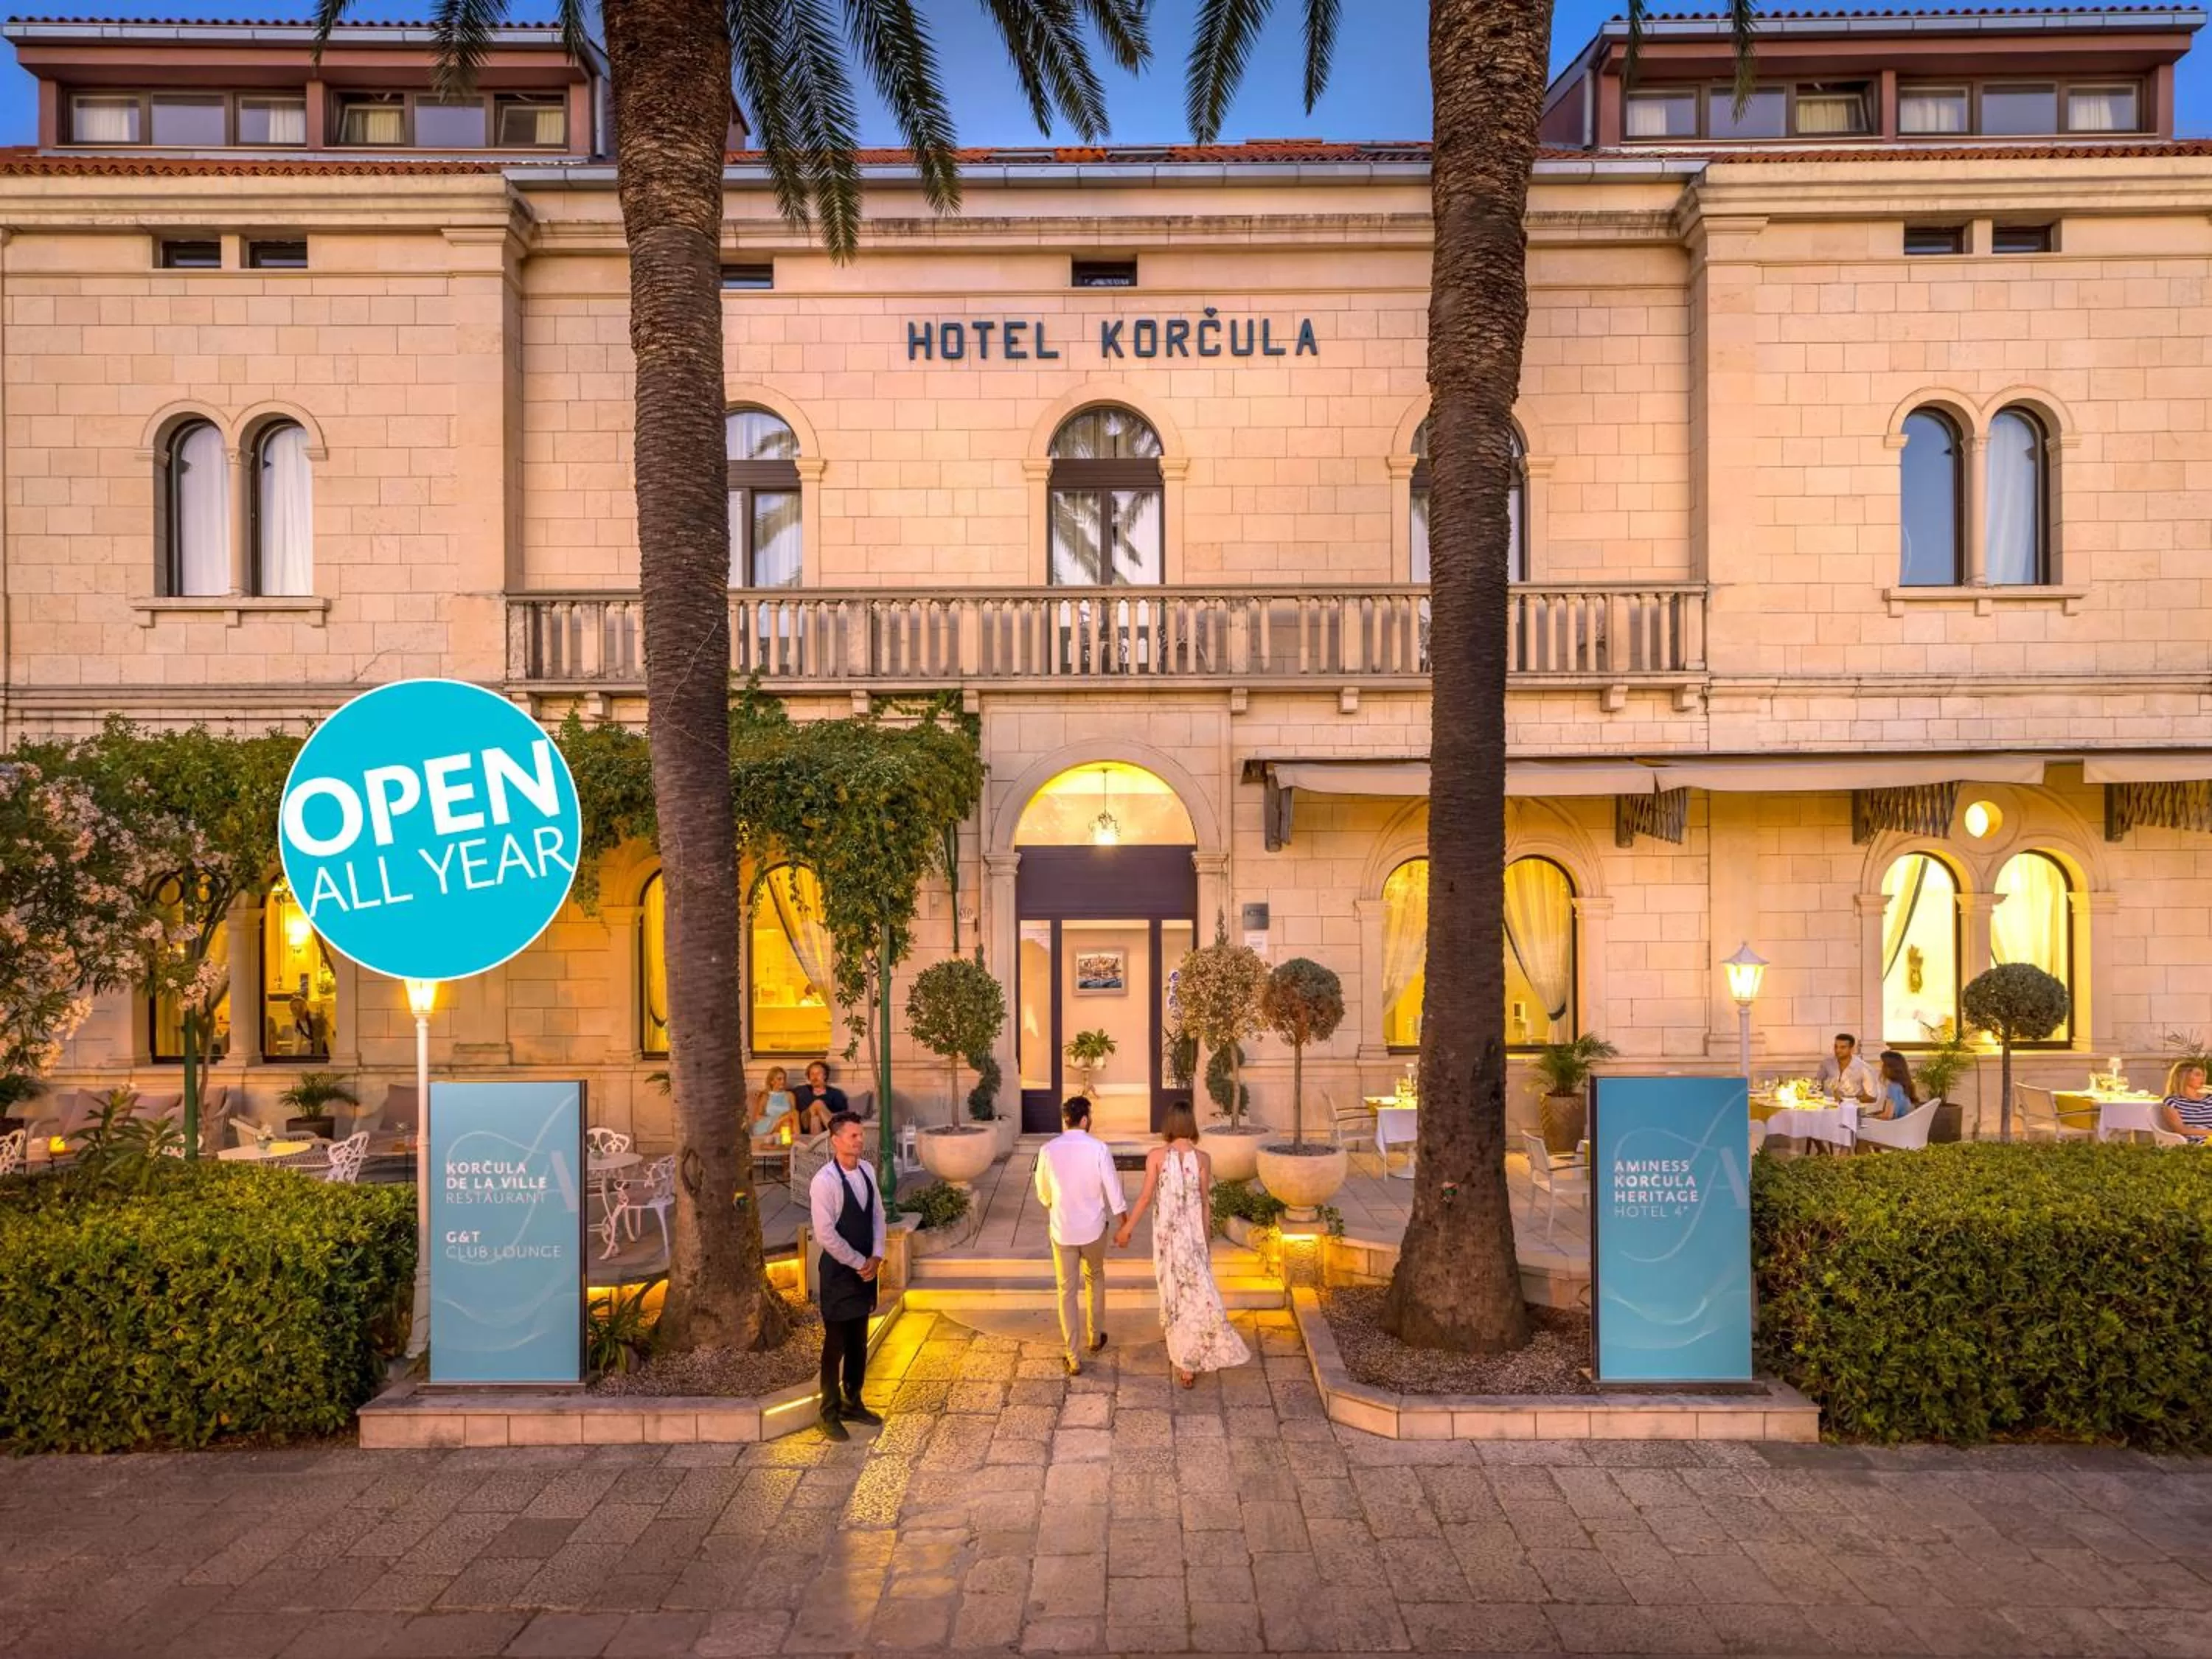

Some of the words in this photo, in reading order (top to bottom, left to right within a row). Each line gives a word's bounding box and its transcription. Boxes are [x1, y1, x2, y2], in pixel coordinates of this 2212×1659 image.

[908, 320, 1060, 361] HOTEL
[1102, 306, 1318, 358] KORČULA
[446, 1160, 526, 1175] KORČULA
[1614, 1160, 1690, 1172] AMINESS
[446, 1177, 467, 1189] DE
[474, 1177, 494, 1189] LA
[501, 1177, 547, 1189] VILLE
[446, 1192, 545, 1204] RESTAURANT
[1614, 1190, 1700, 1203] HERITAGE
[1614, 1206, 1669, 1217] HOTEL
[446, 1231, 481, 1243] G&T
[446, 1245, 488, 1259] CLUB
[494, 1245, 562, 1258] LOUNGE
